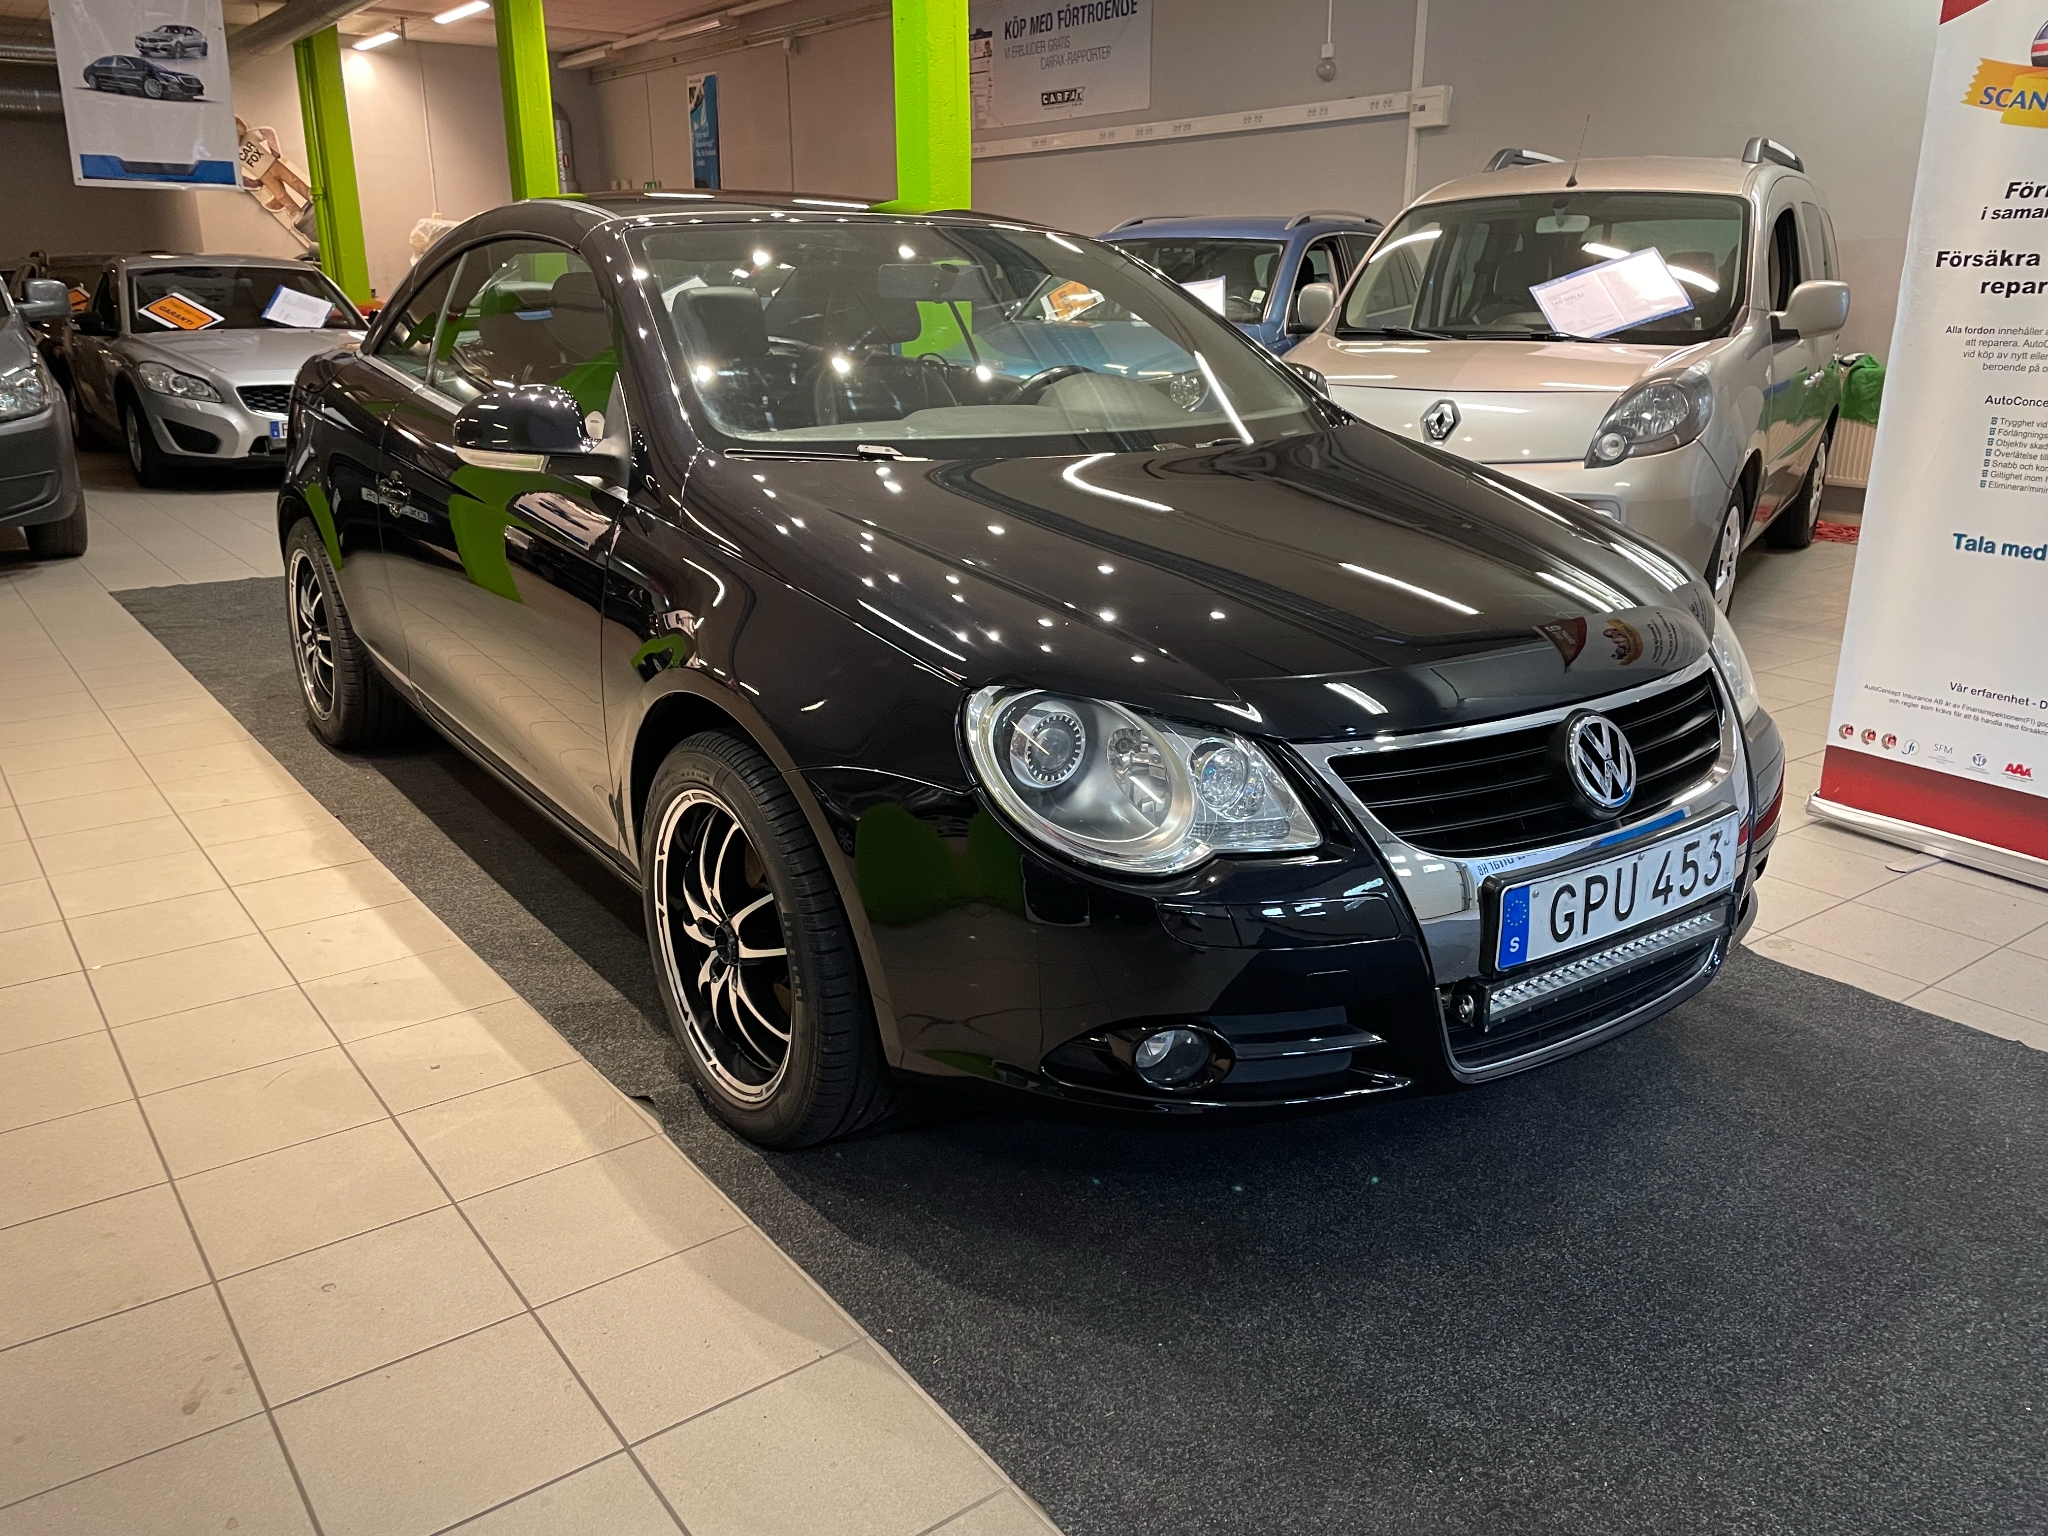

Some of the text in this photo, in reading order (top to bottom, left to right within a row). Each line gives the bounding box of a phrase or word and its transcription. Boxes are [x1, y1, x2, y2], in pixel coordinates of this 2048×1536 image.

[1004, 0, 1138, 40] KÖP MED FÖRTROENDE
[1041, 88, 1084, 105] CARFAX
[1979, 86, 2048, 111] SCAN
[239, 142, 256, 161] CAR
[246, 147, 264, 168] FOX
[1980, 206, 1988, 220] i
[1936, 249, 2040, 268] Försäkra
[158, 305, 196, 326] GARANTI
[1946, 326, 1962, 334] Alla
[1964, 326, 1995, 335] fordon
[1998, 327, 2043, 336] innehåller
[1963, 350, 1975, 358] vid
[1978, 350, 1994, 360] köp
[2010, 352, 2028, 361] nytt
[1982, 362, 2026, 372] beroende
[2028, 363, 2040, 374] på
[1984, 395, 2048, 408] AutoConce
[2000, 418, 2034, 428] Trygghet
[1996, 438, 2028, 449] Objektiv
[1994, 449, 2038, 460] Överlåtelse
[1992, 460, 2018, 469] Snabb
[2020, 463, 2034, 471] och
[1990, 470, 2022, 480] Giltighet
[2024, 474, 2042, 482] inom
[1952, 532, 2048, 561] Tala med
[1864, 684, 1901, 697] AutoConcept
[1902, 692, 1932, 703] Insurance
[1950, 682, 1968, 693] Vår
[1970, 688, 2030, 706] erfarenhet
[1901, 700, 1918, 708] regler
[1920, 704, 1934, 712] som
[2004, 722, 2019, 730] med
[1934, 743, 1954, 754] SFM
[2004, 763, 2032, 778] AAA
[1550, 830, 1722, 943] GPU 453
[1509, 937, 1520, 954] S
